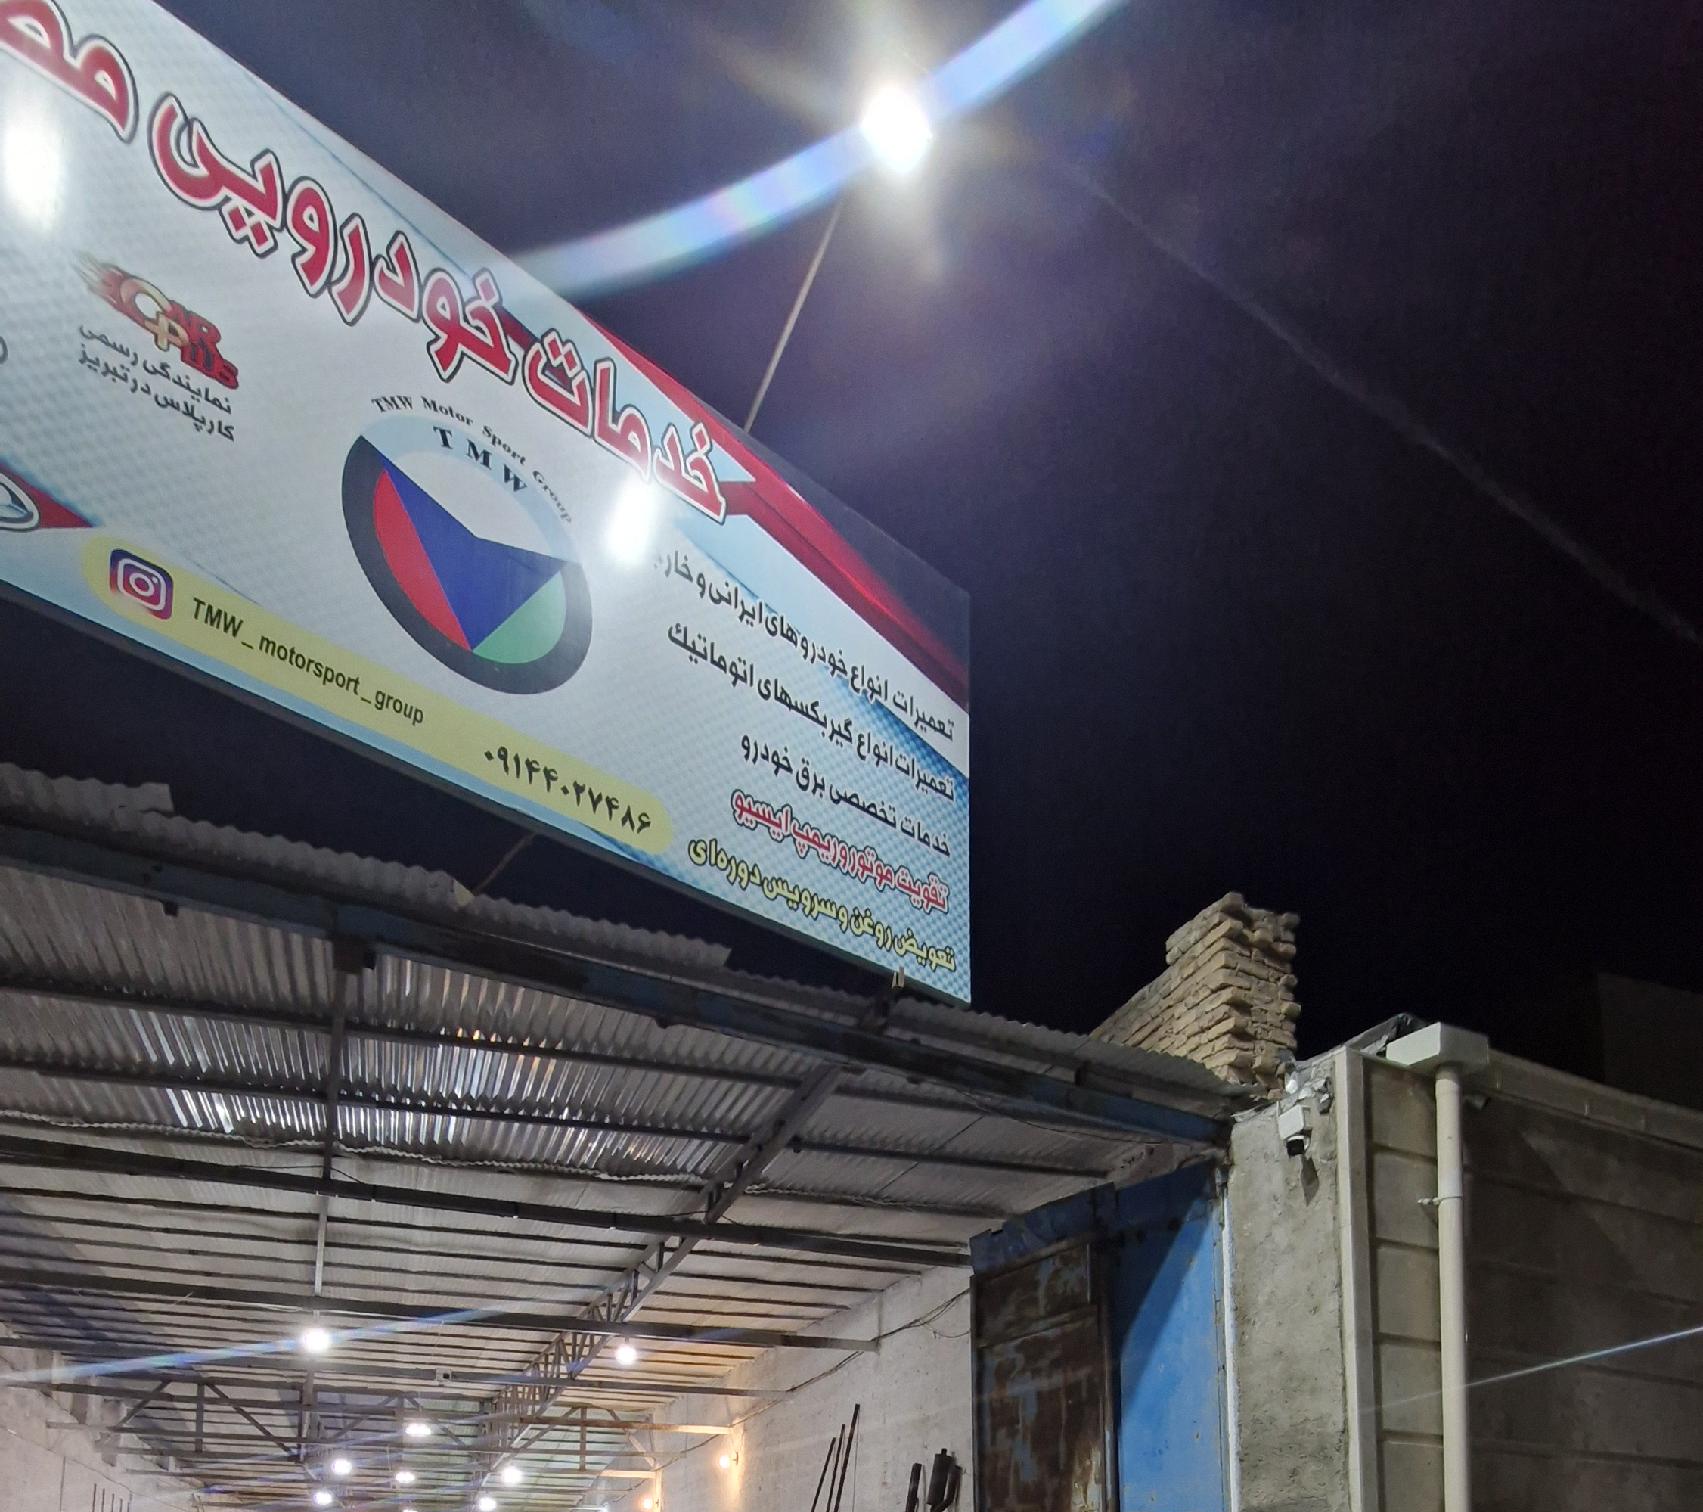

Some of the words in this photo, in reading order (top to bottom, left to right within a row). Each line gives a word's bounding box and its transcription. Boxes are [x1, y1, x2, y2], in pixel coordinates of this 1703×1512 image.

[147, 91, 517, 382] خودرویی
[78, 343, 131, 383] تبریز
[79, 325, 139, 366] رسمی
[143, 360, 232, 415] نمایندگی
[523, 328, 727, 525] خدمات
[371, 395, 413, 413] TMW
[420, 396, 474, 427] Motor
[481, 425, 527, 466] Sport
[532, 470, 573, 524] Group
[708, 581, 763, 628] ایرانی
[850, 664, 889, 704] انواع
[892, 688, 956, 743] تعمیرات
[741, 734, 793, 776] خودرو
[857, 731, 894, 770] انواع
[796, 757, 826, 797] برق
[895, 752, 956, 802] تعمیرات
[829, 783, 897, 830] تخصصی
[900, 813, 951, 858] خدمات
[761, 876, 839, 920] سرویس
[896, 865, 950, 915] تقویت
[850, 906, 893, 950] روغن
[893, 927, 957, 972] تعویض
